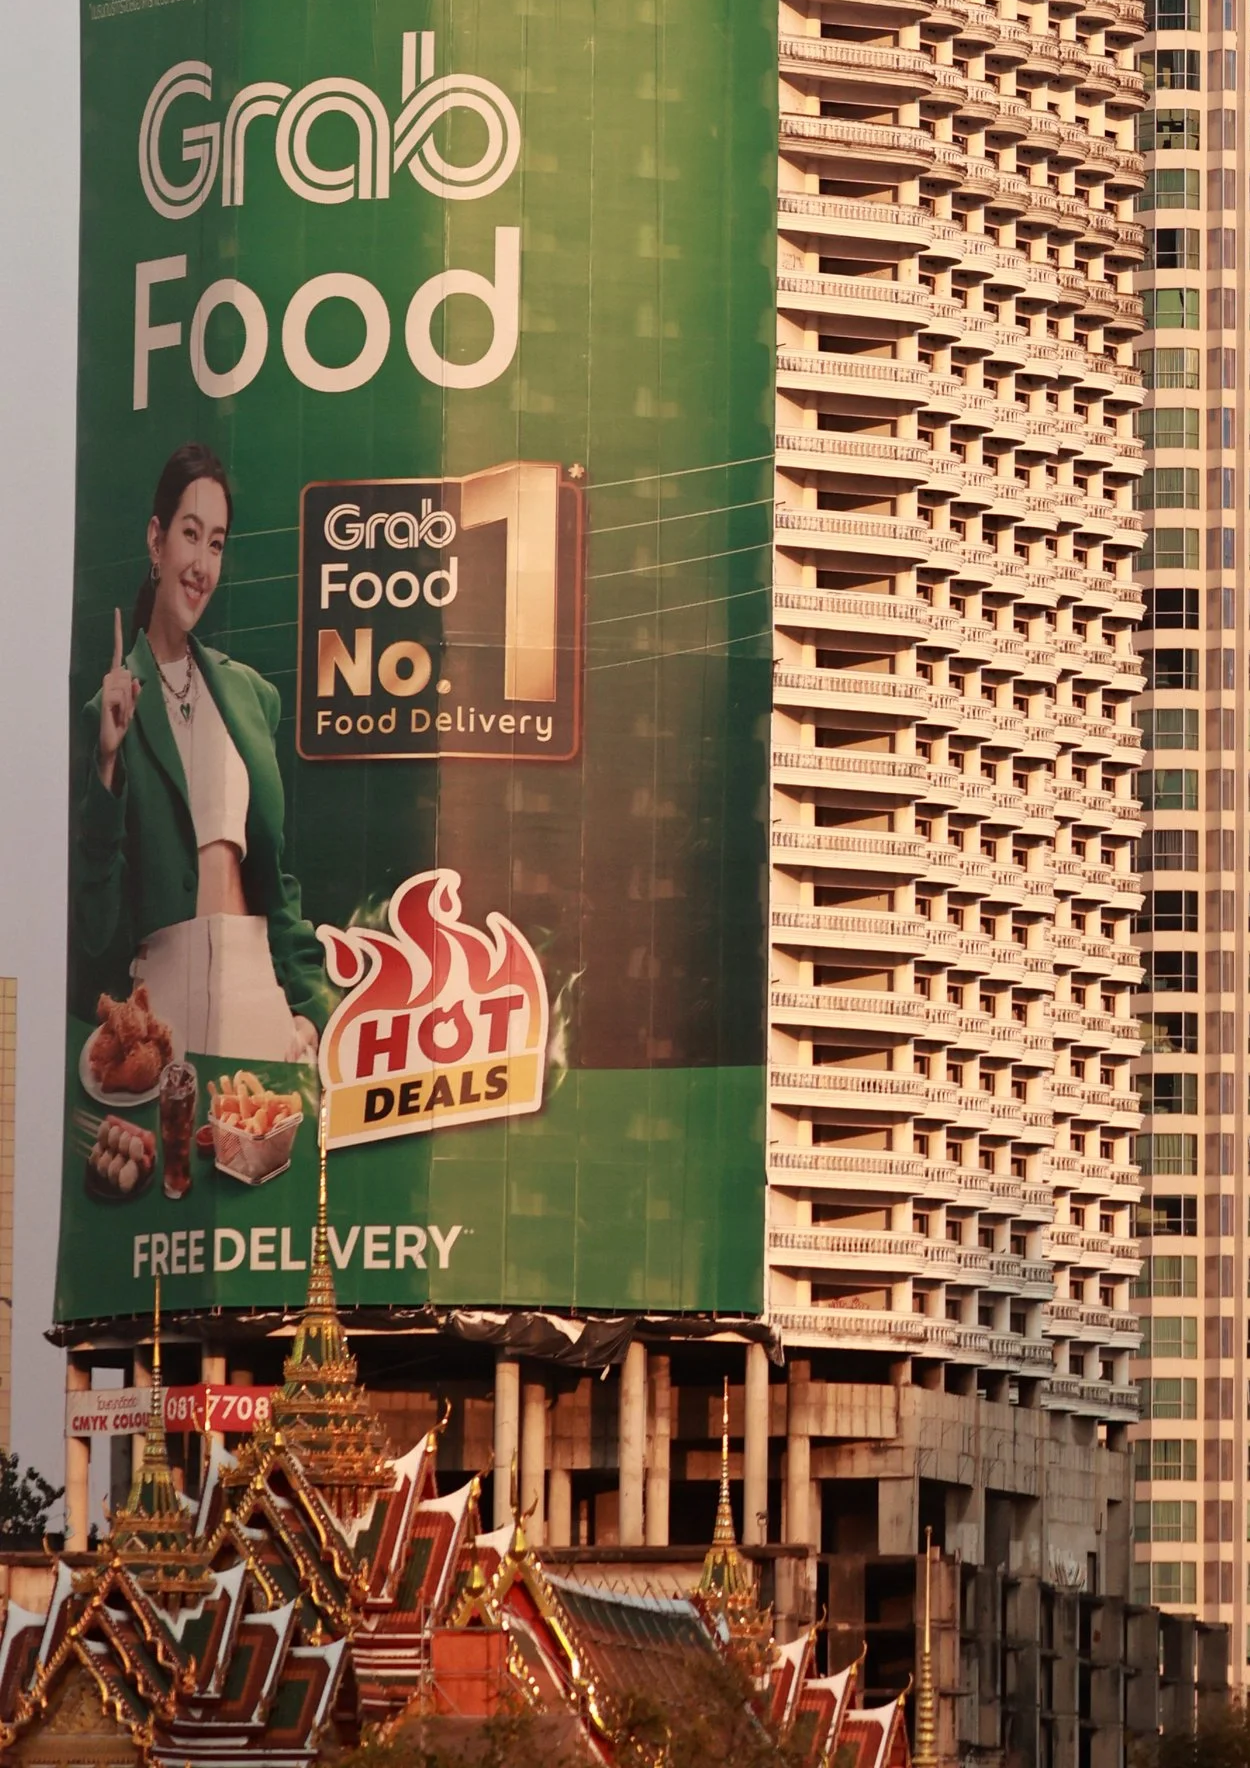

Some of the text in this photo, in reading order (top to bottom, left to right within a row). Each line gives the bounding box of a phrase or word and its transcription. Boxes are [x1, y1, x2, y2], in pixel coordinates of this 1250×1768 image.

[139, 31, 521, 220] Grab
[132, 226, 521, 411] Food
[323, 498, 457, 551] Grab
[319, 557, 458, 610] Food
[317, 629, 452, 698] No.
[317, 707, 553, 742] Food Delivery
[355, 994, 524, 1077] HOT
[363, 1065, 508, 1123] DEALS
[133, 1229, 205, 1278] FREE
[72, 1412, 151, 1431] CMYK COLOU
